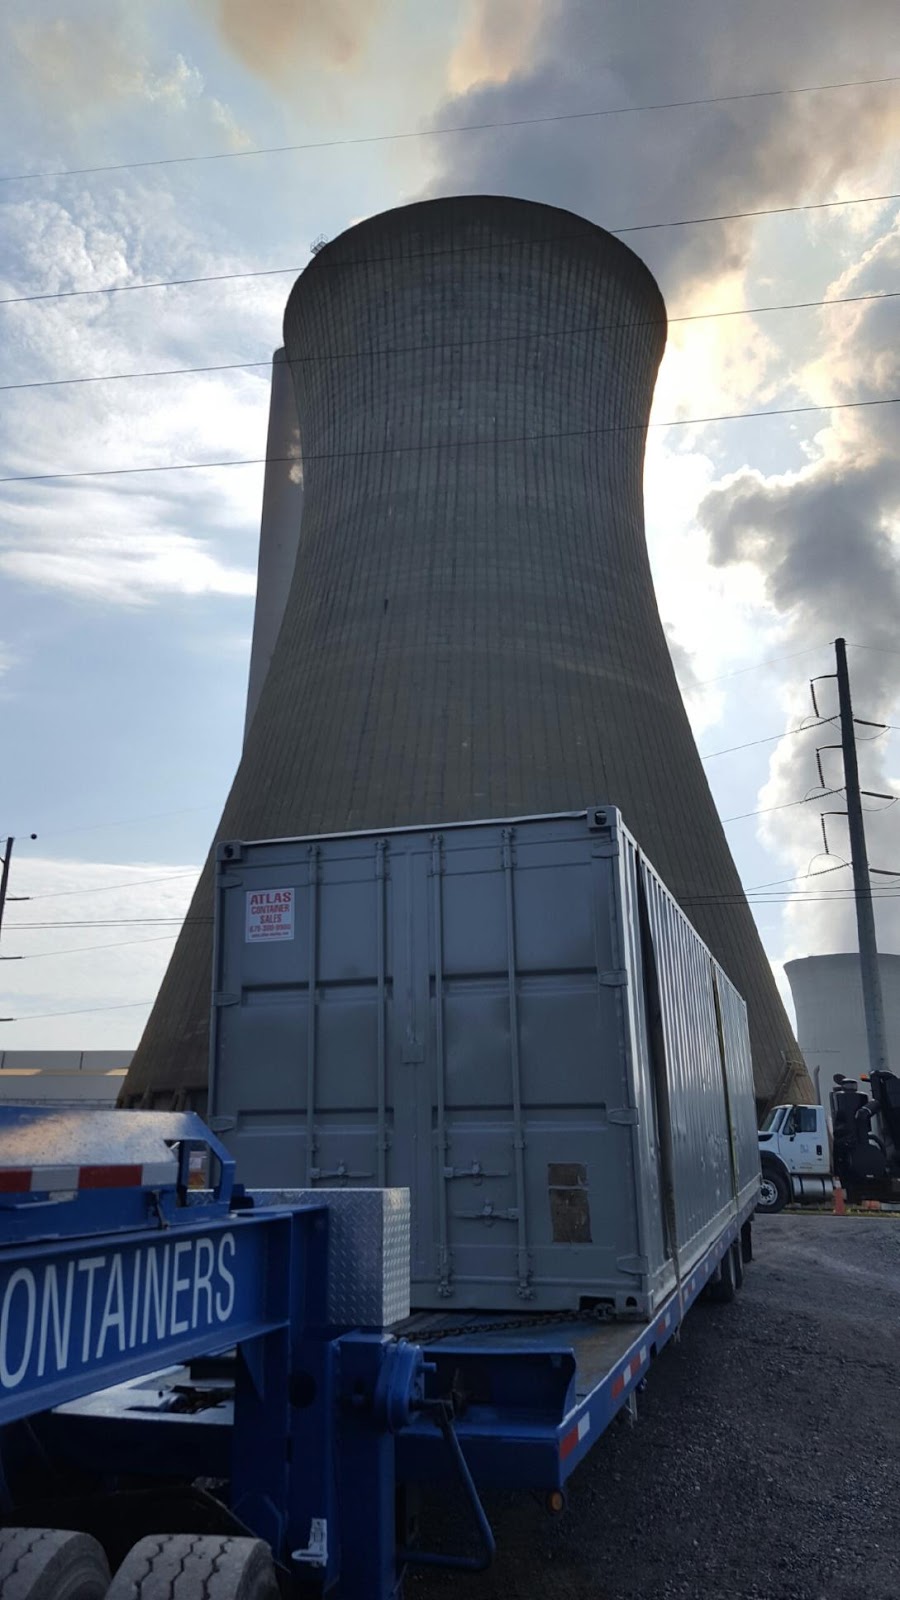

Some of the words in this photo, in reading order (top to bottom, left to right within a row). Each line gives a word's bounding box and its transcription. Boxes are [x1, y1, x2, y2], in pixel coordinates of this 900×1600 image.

[250, 892, 292, 905] ATLAS
[251, 904, 290, 915] CONTAINER
[260, 913, 282, 924] SALES
[0, 1232, 236, 1388] ONTAINERS
